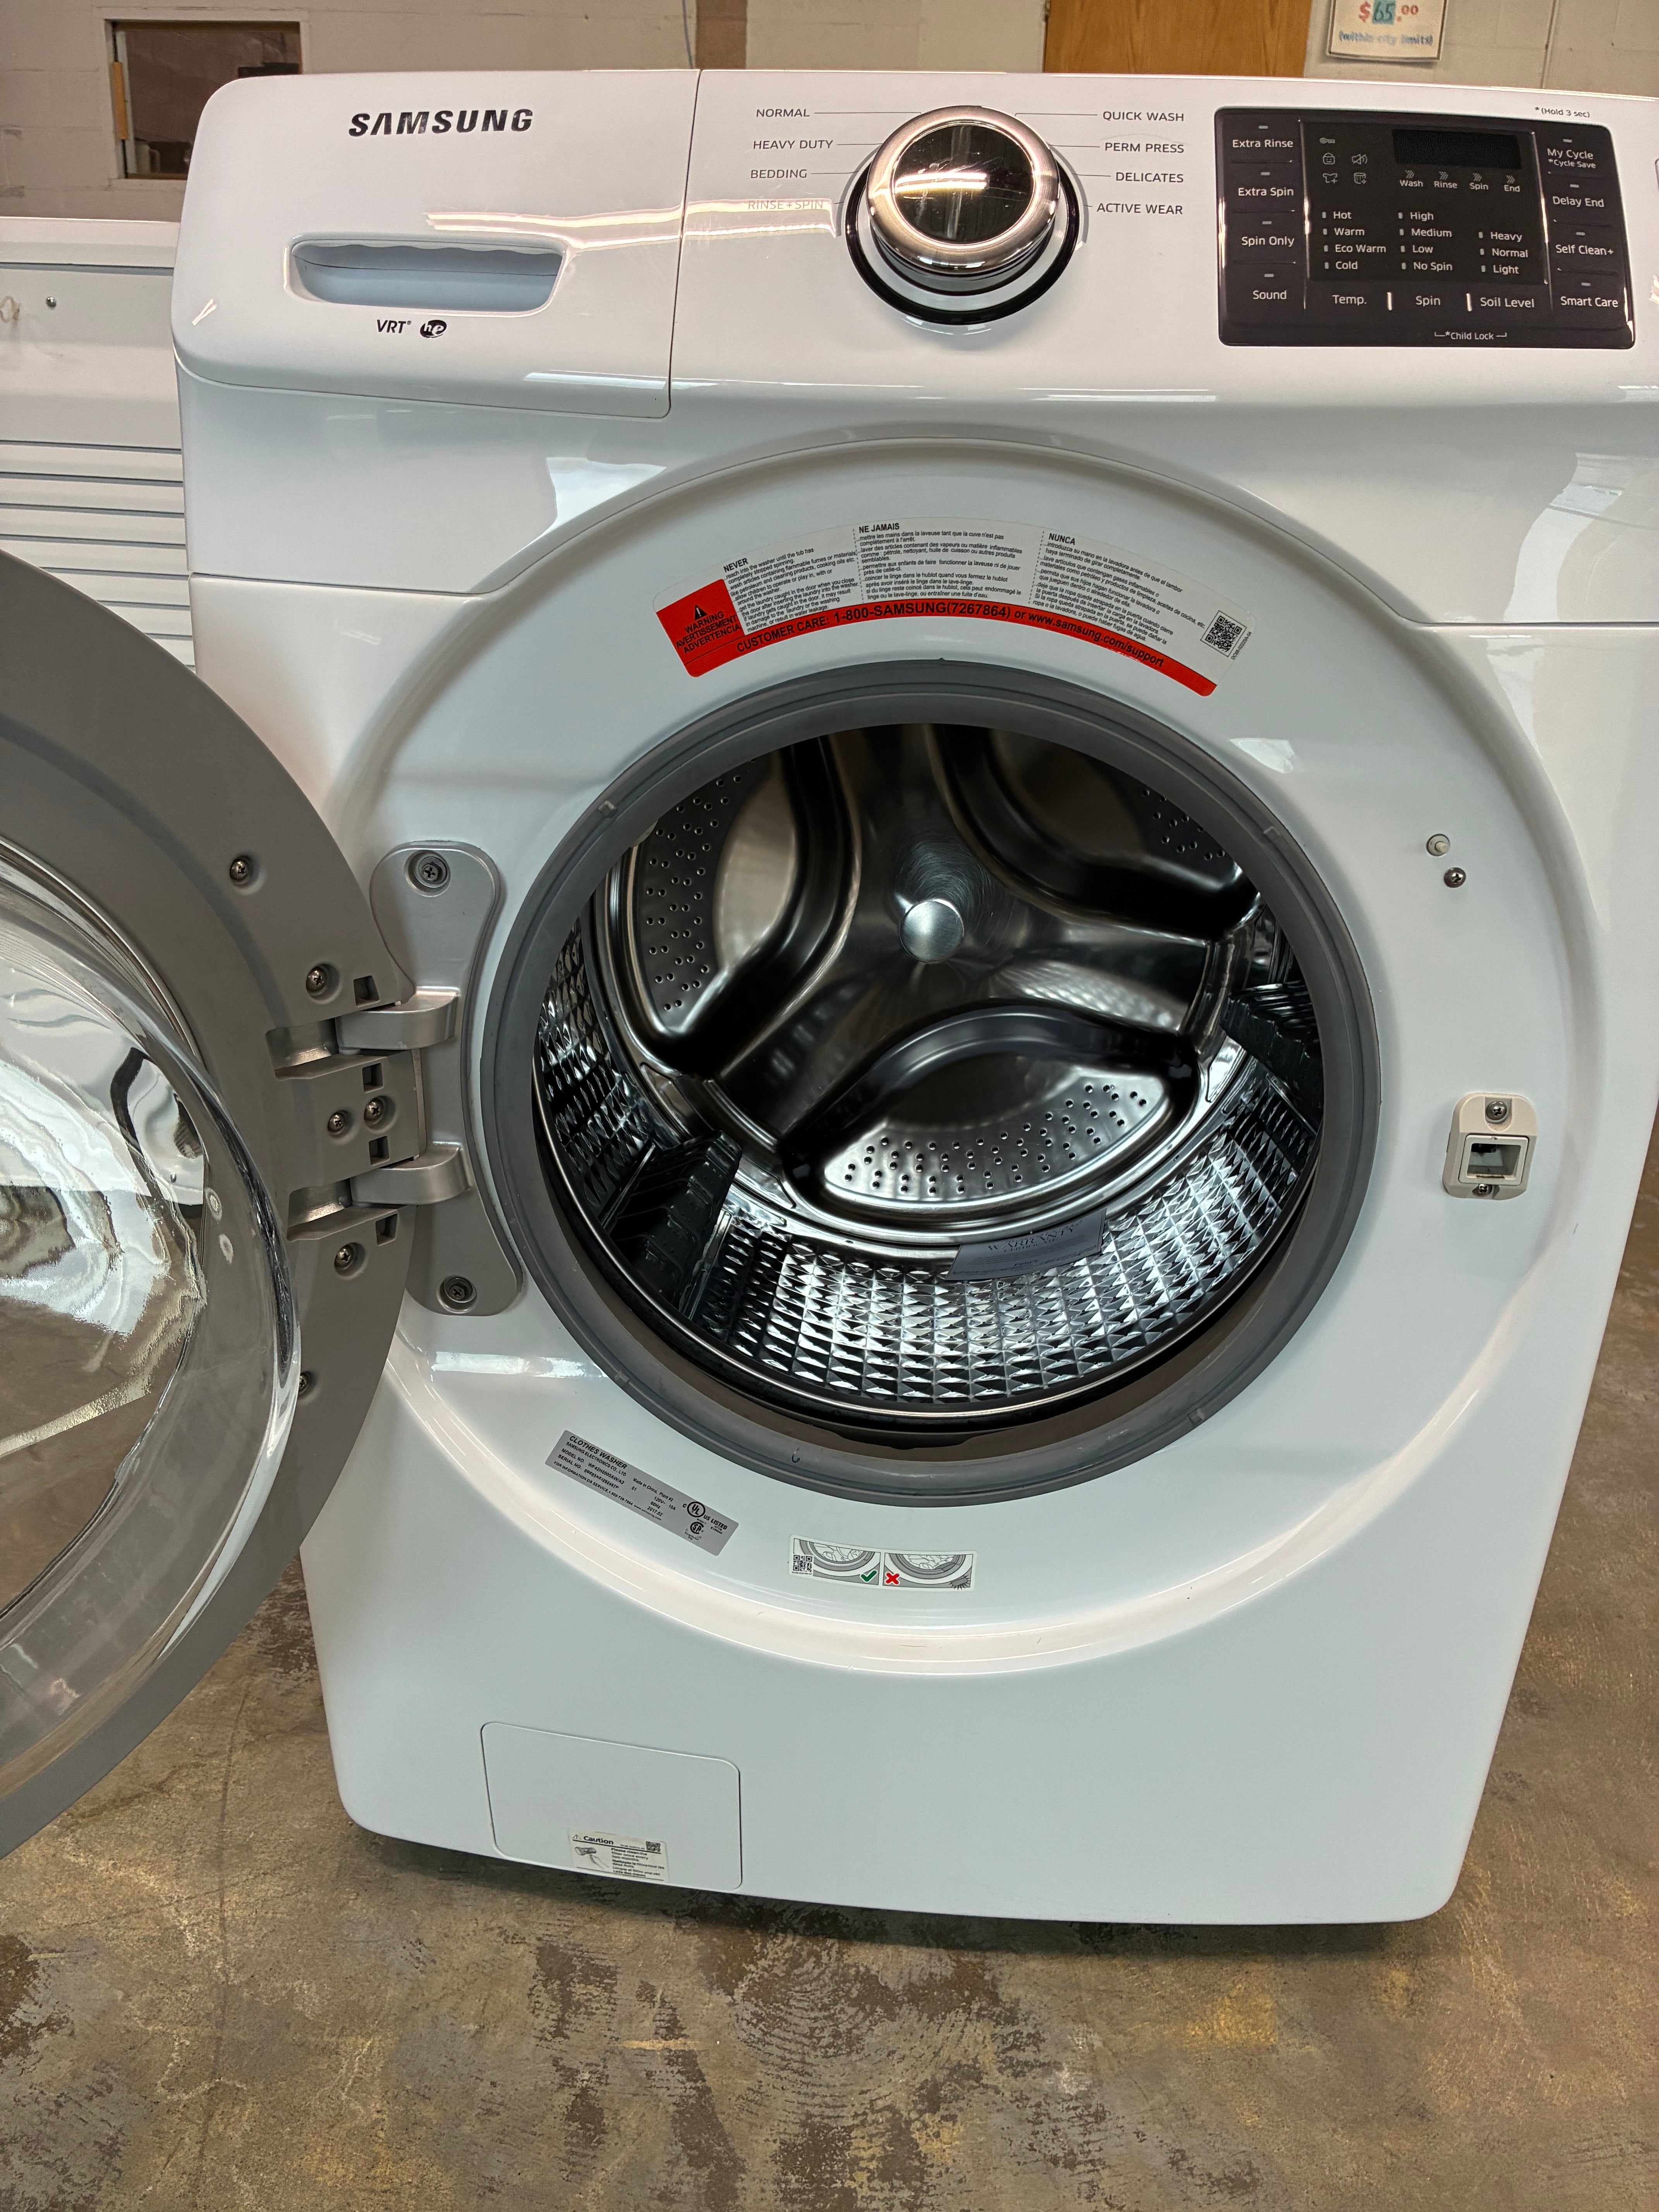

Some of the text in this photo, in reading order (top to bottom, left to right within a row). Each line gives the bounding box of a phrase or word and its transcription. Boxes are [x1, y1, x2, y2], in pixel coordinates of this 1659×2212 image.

[756, 108, 810, 117] NORMAL
[1103, 111, 1184, 122] QUICK WASH
[349, 109, 533, 137] SAMSUNG
[753, 140, 833, 149] HEAVY DUTY
[1105, 142, 1184, 153] PERM PRESS
[1232, 139, 1293, 148] Extra Rinse
[1547, 148, 1594, 160] My Cycle
[750, 169, 807, 179] BEDDING
[1116, 172, 1183, 183] DELICATES
[1470, 182, 1489, 191] Spin
[1238, 187, 1294, 198] Extra Spin
[1553, 196, 1604, 207] Delay End
[1096, 203, 1183, 215] ACTIVE WEAR
[1333, 211, 1352, 219] Hot
[1410, 212, 1434, 222] High
[1334, 228, 1365, 236] Warm
[1411, 228, 1452, 237] Medium
[1490, 232, 1522, 242] Heavy
[1242, 236, 1295, 247] Spin Only
[1335, 244, 1386, 253] Eco Warm
[1412, 245, 1433, 253] Low
[1492, 248, 1528, 258] Normal
[1556, 244, 1614, 255] Self Clean+
[1336, 261, 1358, 270] Cold
[1413, 262, 1453, 272] No Spin
[1493, 264, 1519, 275] Light
[1253, 290, 1286, 300] Sound
[1332, 295, 1367, 306] Temp.
[1415, 295, 1441, 307] Spin
[1480, 297, 1534, 308] Soil Level
[1560, 296, 1618, 307] Smart Care
[859, 522, 900, 533] NE JAMAIS
[1048, 532, 1075, 545] NUNCA
[723, 558, 748, 572] NEVER
[785, 560, 810, 570] flammable
[728, 571, 752, 584] completely
[684, 611, 724, 634] WARNING
[676, 614, 737, 649] AVERTISSEMENT
[737, 602, 1164, 667] CUSTOMER CARE: 1-800-SAMSUNG(7267864) or www.samsung.com/support
[684, 623, 741, 654] ADVERTENCIA
[561, 1448, 576, 1459] MODEL
[566, 1441, 585, 1454] SAMSUNG
[584, 1451, 611, 1468] ELECTRONICS
[569, 1436, 627, 1469] CLOTHES WASHER
[558, 1454, 573, 1465] SERIAL
[710, 1518, 728, 1530] LISTED
[583, 1836, 613, 1845] Caution
